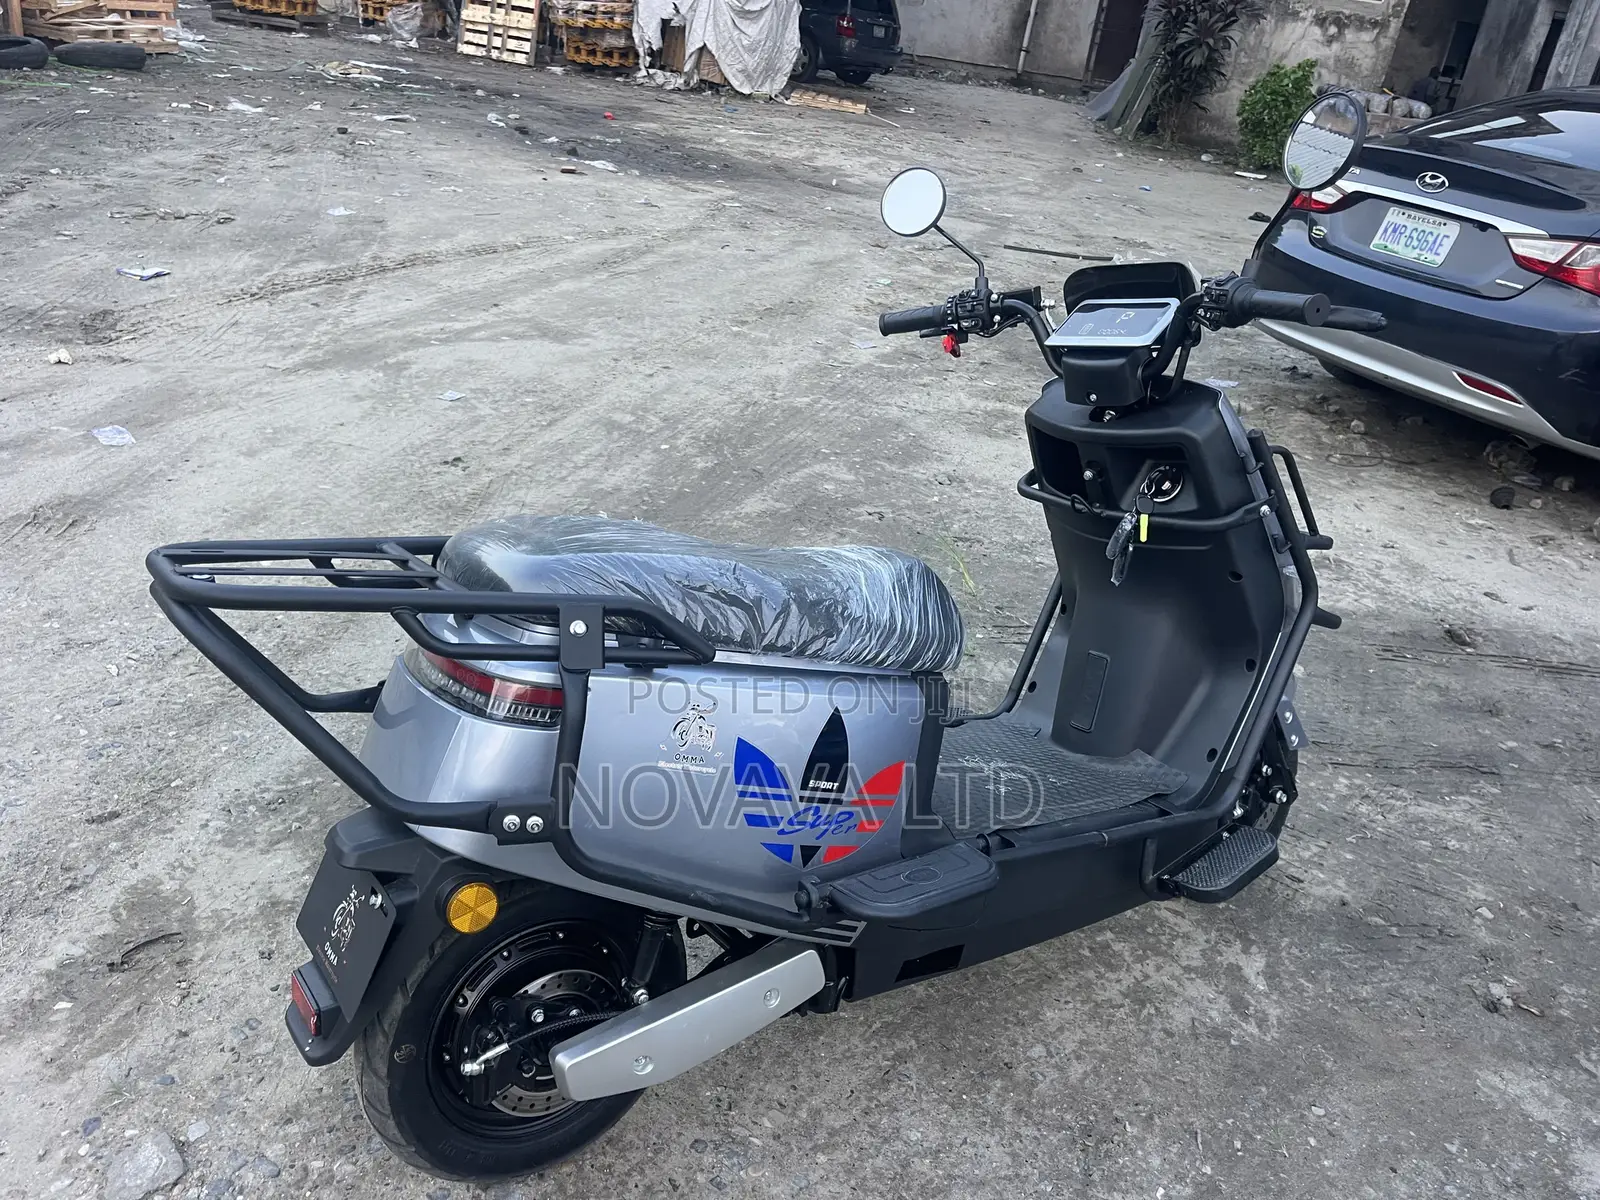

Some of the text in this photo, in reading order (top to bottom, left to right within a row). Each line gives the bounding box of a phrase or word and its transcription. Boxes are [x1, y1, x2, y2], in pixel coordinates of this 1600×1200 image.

[1406, 214, 1442, 227] BAYELSA
[674, 753, 705, 763] OMMA
[808, 780, 839, 790] SPORT
[324, 941, 338, 966] OMMA
